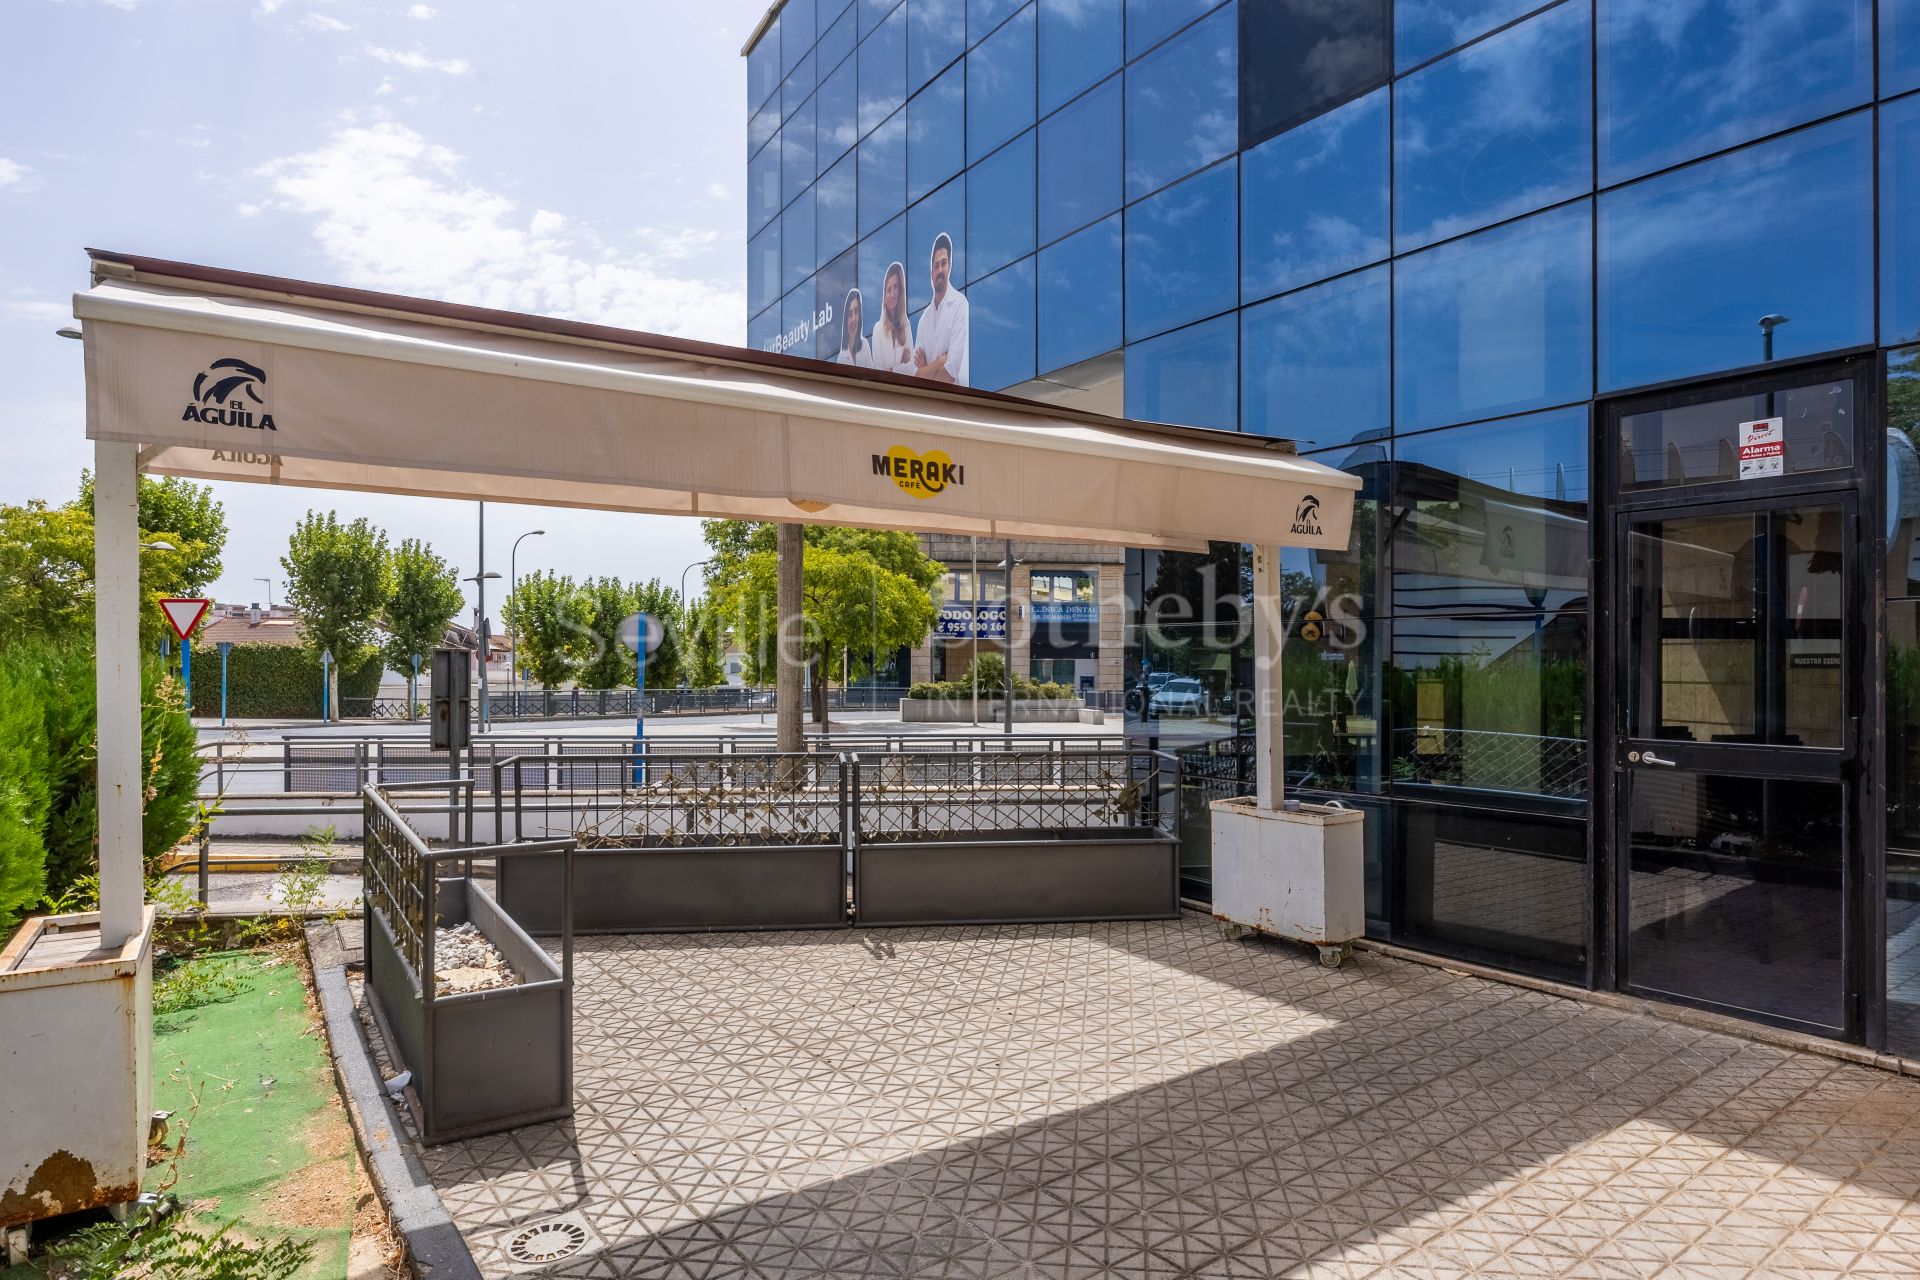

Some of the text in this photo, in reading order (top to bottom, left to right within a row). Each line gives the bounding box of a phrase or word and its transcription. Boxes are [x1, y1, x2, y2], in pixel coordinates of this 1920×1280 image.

[813, 302, 833, 332] Lab
[229, 400, 246, 411] EL
[182, 402, 277, 431] ÁGUILA
[1742, 444, 1781, 455] Alarma
[872, 454, 965, 492] MERAKI
[947, 622, 967, 632] 955
